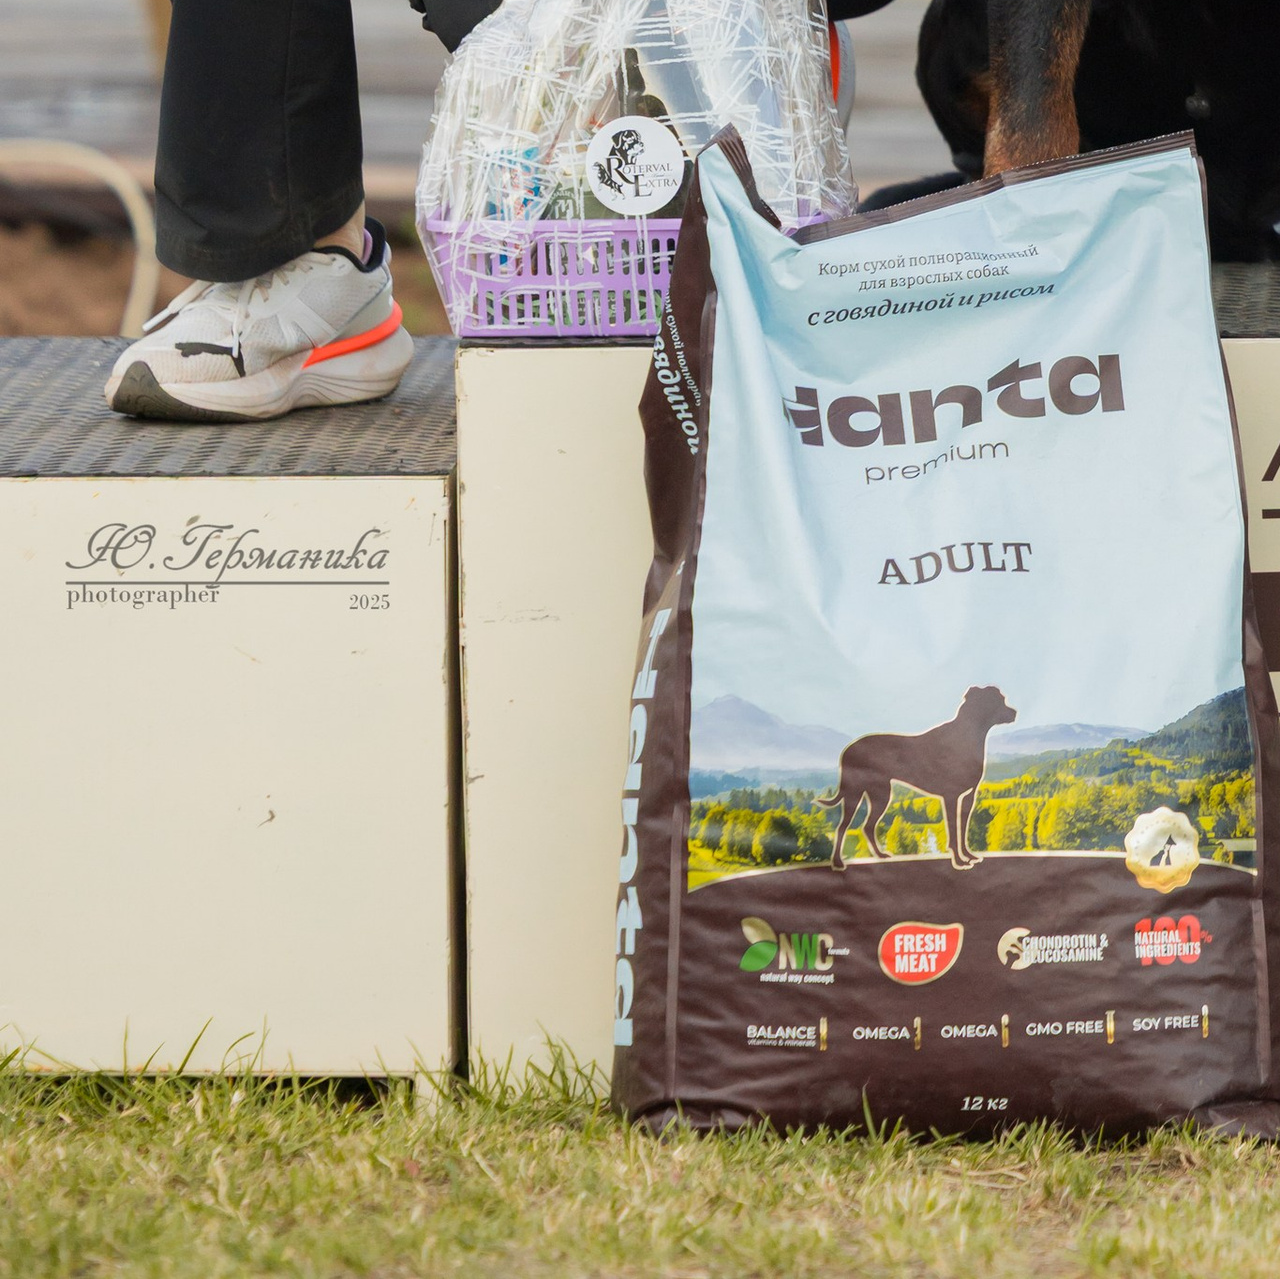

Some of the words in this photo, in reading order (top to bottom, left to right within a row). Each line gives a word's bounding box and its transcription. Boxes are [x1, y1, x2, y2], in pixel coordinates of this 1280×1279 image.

[818, 261, 861, 278] Корм
[863, 254, 905, 275] сухой
[858, 279, 887, 293] для
[890, 271, 964, 290] взрослых
[966, 263, 1010, 280] собак
[807, 311, 820, 327] с
[823, 292, 955, 325] говядиной
[957, 294, 973, 308] и
[973, 282, 1056, 309] рисом
[864, 441, 1010, 485] premium
[877, 542, 1033, 586] ADULT
[894, 933, 947, 953] FRESH
[1100, 932, 1109, 948] &
[1134, 929, 1182, 945] NATURAL
[778, 932, 834, 971] NWC
[1022, 947, 1105, 964] GLUCOSAMINE
[1135, 941, 1201, 959] INGREDIENTS
[894, 953, 938, 974] MEAT
[747, 1025, 817, 1039] BALANCE
[940, 1024, 998, 1039] OMEGA
[1025, 1022, 1063, 1036] GMO
[1066, 1020, 1104, 1035] FREE
[1132, 1017, 1161, 1032] SOY
[1164, 1014, 1200, 1030] FREE
[853, 1026, 910, 1040] OMEGA
[960, 1095, 984, 1110] 12
